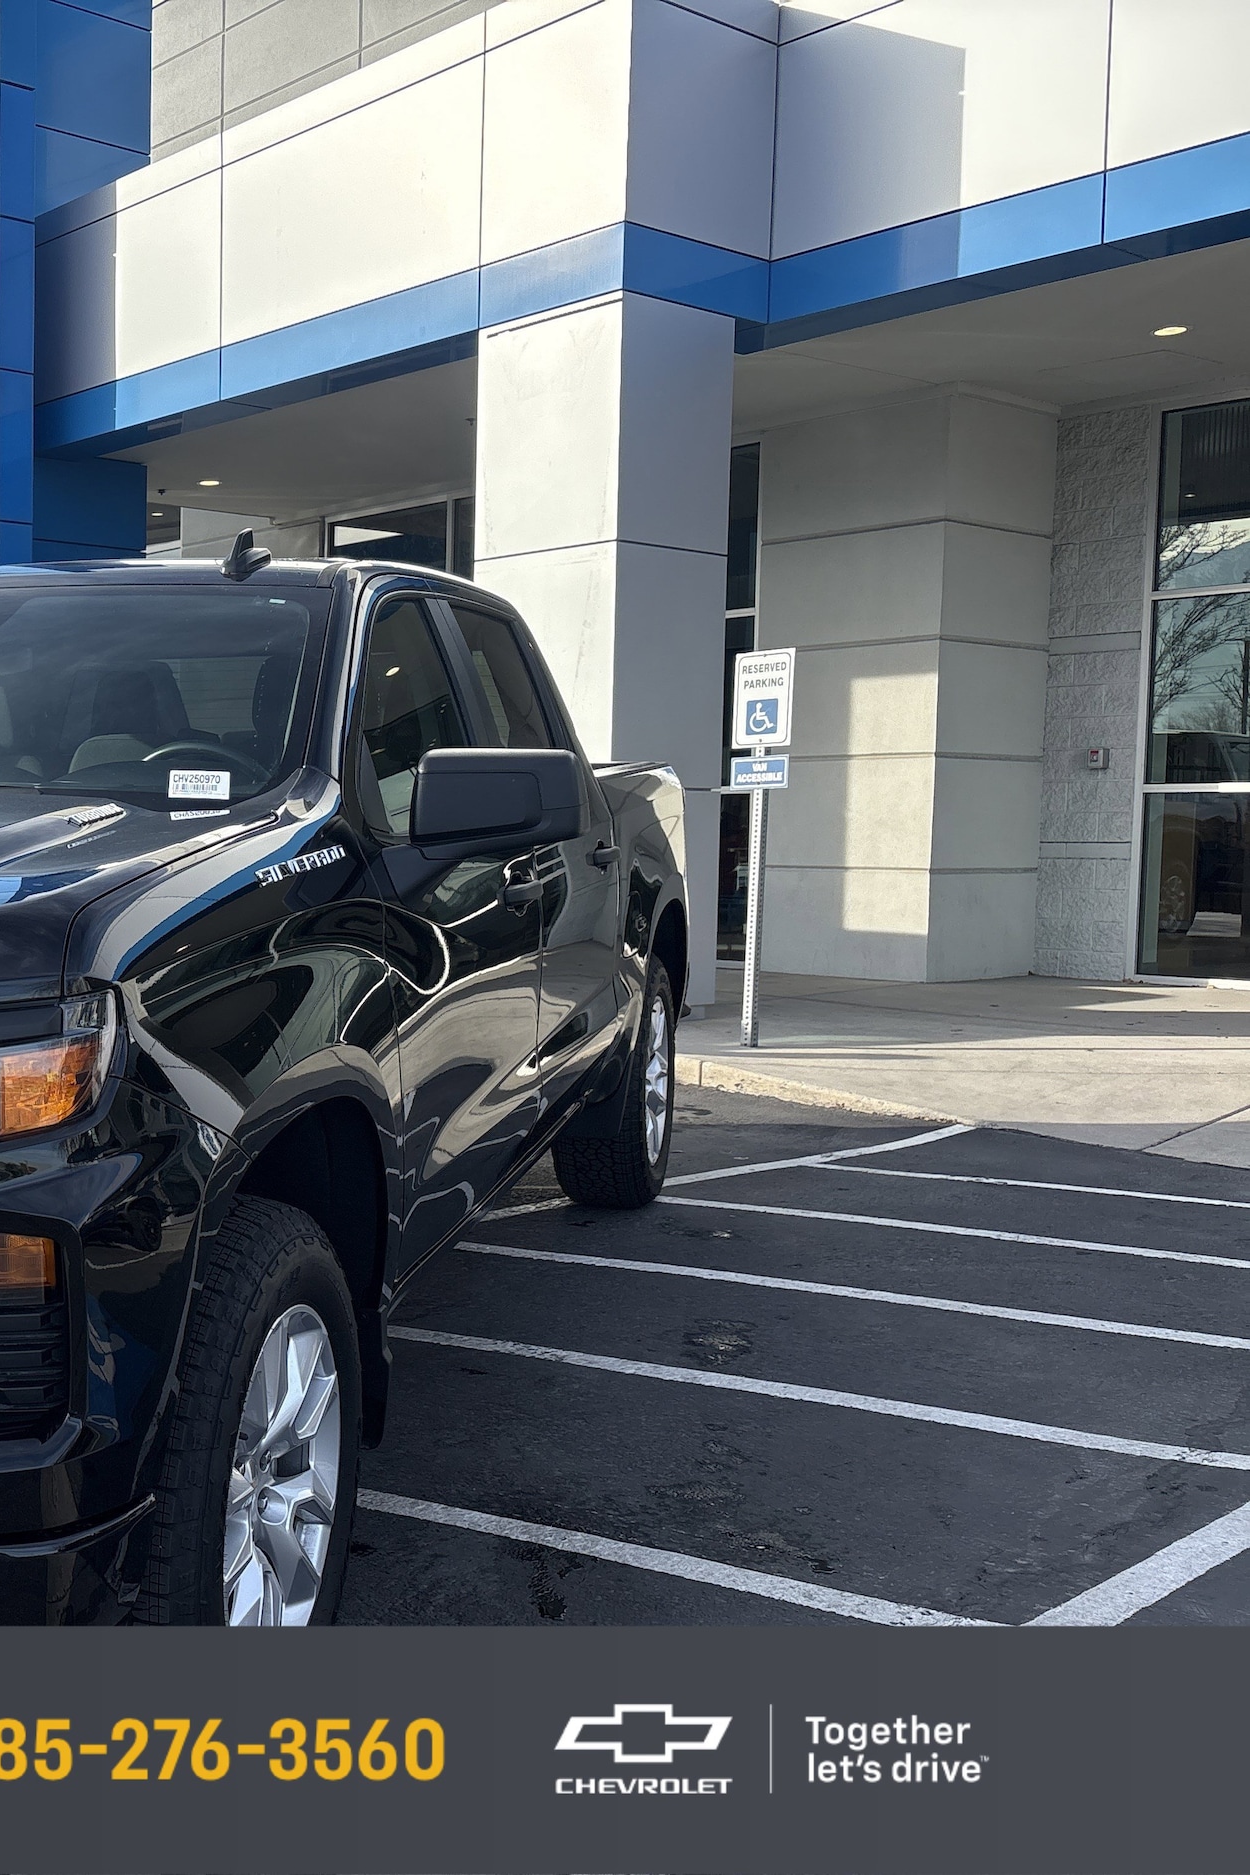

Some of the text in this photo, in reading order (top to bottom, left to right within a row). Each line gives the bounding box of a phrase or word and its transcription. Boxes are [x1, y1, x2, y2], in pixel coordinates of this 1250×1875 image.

[742, 661, 787, 675] RESERVED
[744, 677, 784, 690] PARKING
[752, 762, 768, 772] VAN
[173, 774, 221, 784] CHV250970
[736, 771, 783, 783] ACCESSIBLE
